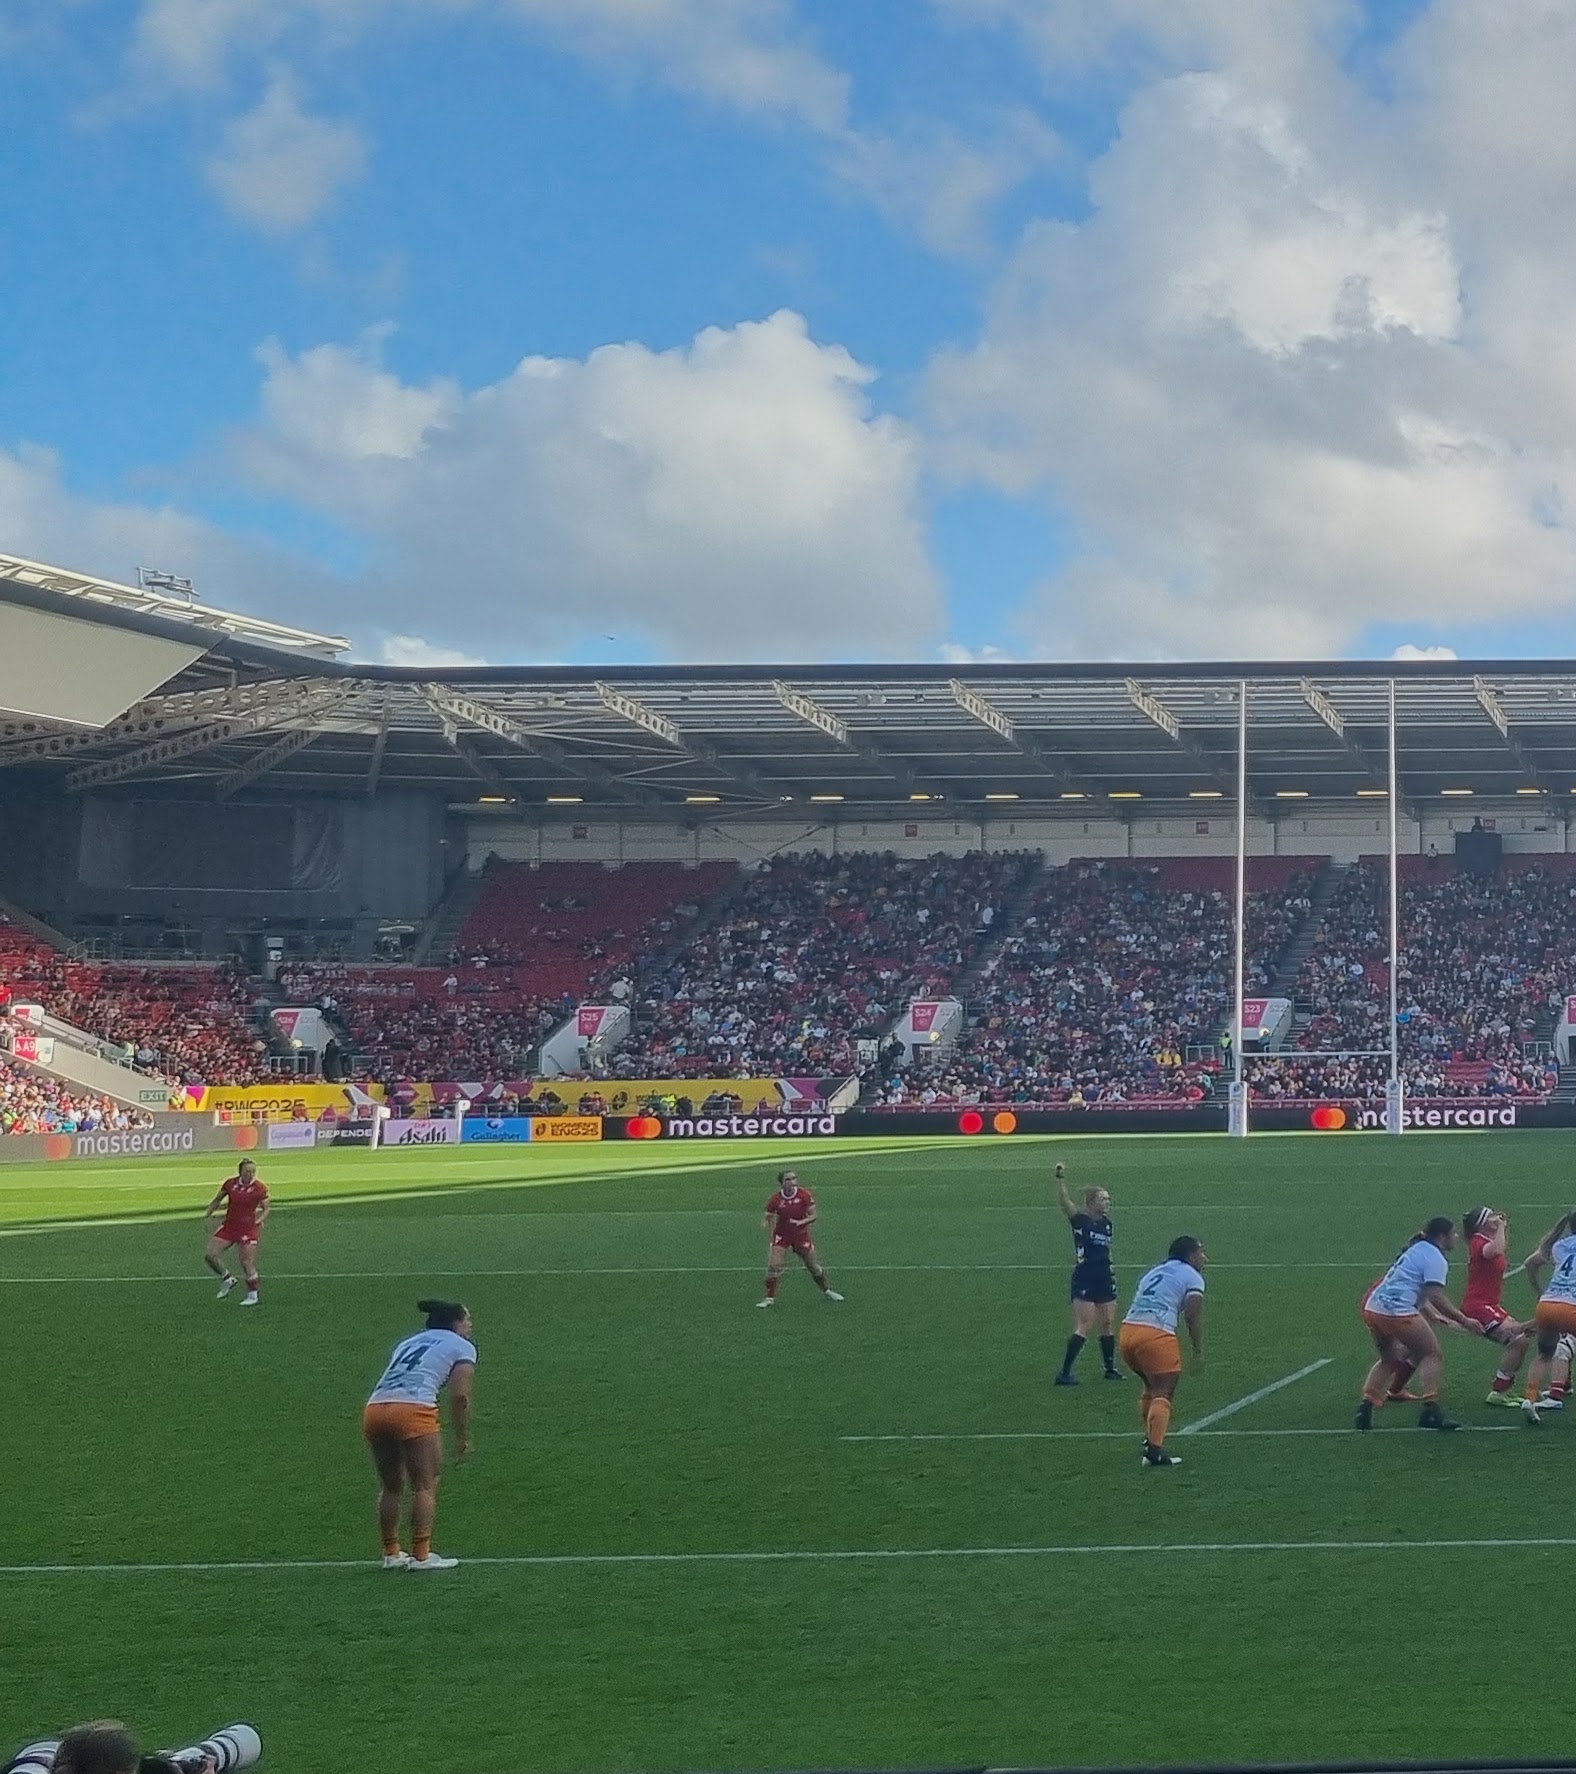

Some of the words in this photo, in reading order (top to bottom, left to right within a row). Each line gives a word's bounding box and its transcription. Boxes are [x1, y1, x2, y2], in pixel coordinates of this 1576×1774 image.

[914, 1008, 933, 1017] S24
[1244, 1004, 1261, 1013] S23
[581, 1013, 599, 1021] S25
[140, 1091, 166, 1101] EXIT
[317, 1128, 374, 1138] DEFENDE
[668, 1114, 836, 1136] mastercard
[76, 1127, 194, 1155] mastercard
[400, 1125, 447, 1144] Asahi
[470, 1130, 521, 1143] Gallagher
[1561, 1254, 1576, 1278] 4
[1142, 1273, 1164, 1297] 2
[389, 1345, 431, 1371] 14
